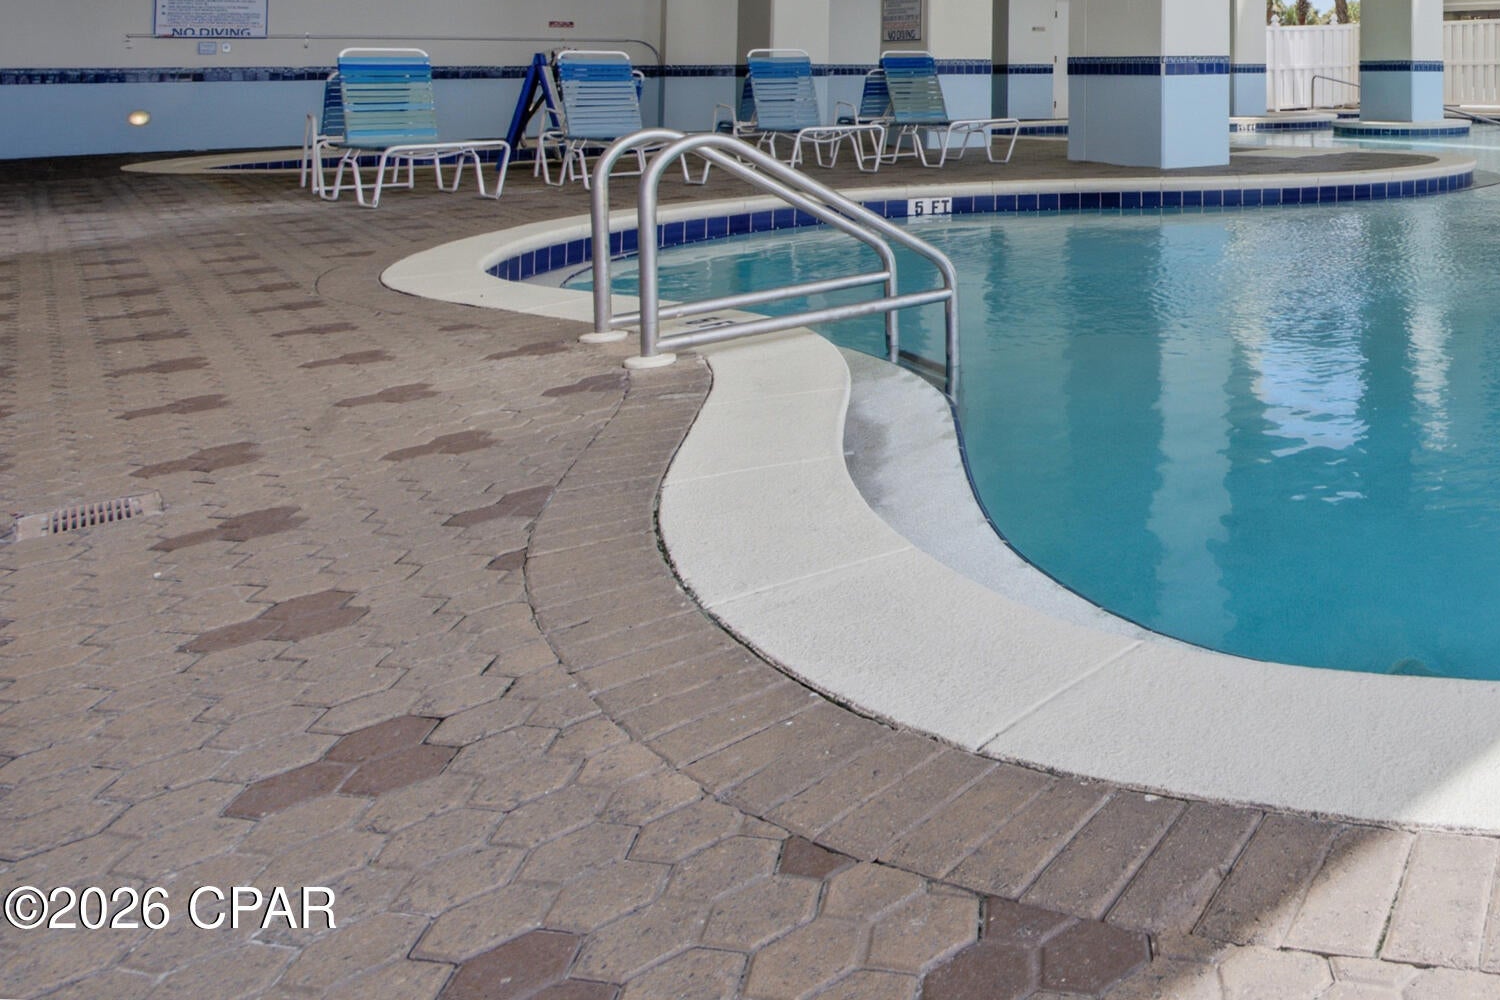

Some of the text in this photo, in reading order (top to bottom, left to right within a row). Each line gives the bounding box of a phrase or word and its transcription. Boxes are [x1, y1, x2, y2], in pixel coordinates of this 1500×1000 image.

[172, 27, 251, 36] NO DIVING
[914, 199, 950, 215] 5 FT
